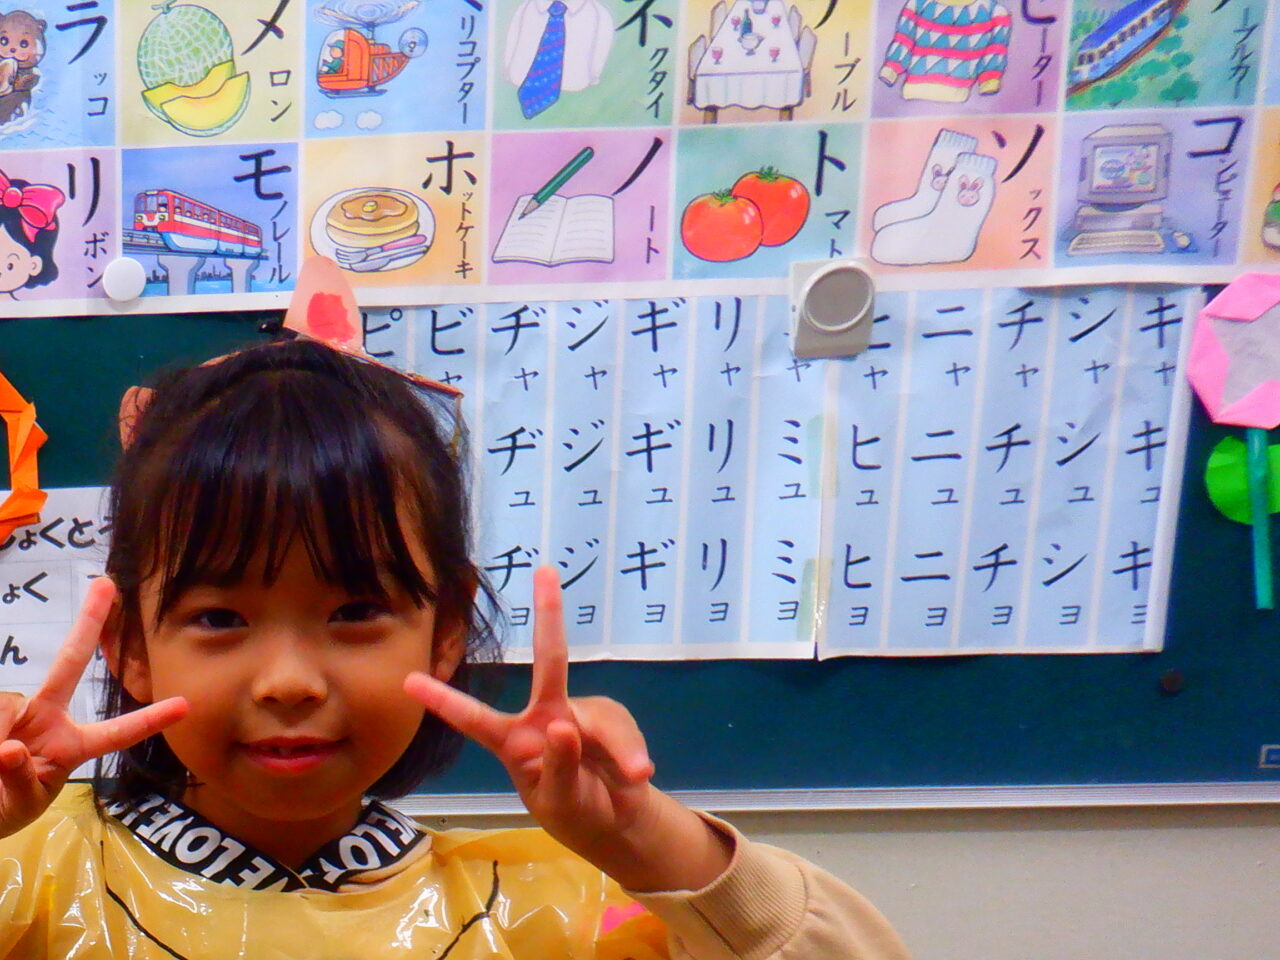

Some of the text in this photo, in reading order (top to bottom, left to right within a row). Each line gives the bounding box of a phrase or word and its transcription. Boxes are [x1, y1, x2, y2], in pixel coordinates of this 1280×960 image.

[55, 0, 108, 116] ラッコ
[241, 0, 292, 122] メロン
[456, 0, 483, 124] リコプター
[814, 0, 861, 111] ーブル
[1211, 0, 1258, 99] ーブルカー
[67, 157, 108, 289] リボン
[233, 149, 292, 284] モノレール
[422, 140, 478, 279] ホットケーキ
[611, 136, 664, 264] ノート
[815, 129, 852, 258] トマト
[992, 124, 1045, 260] ソックス
